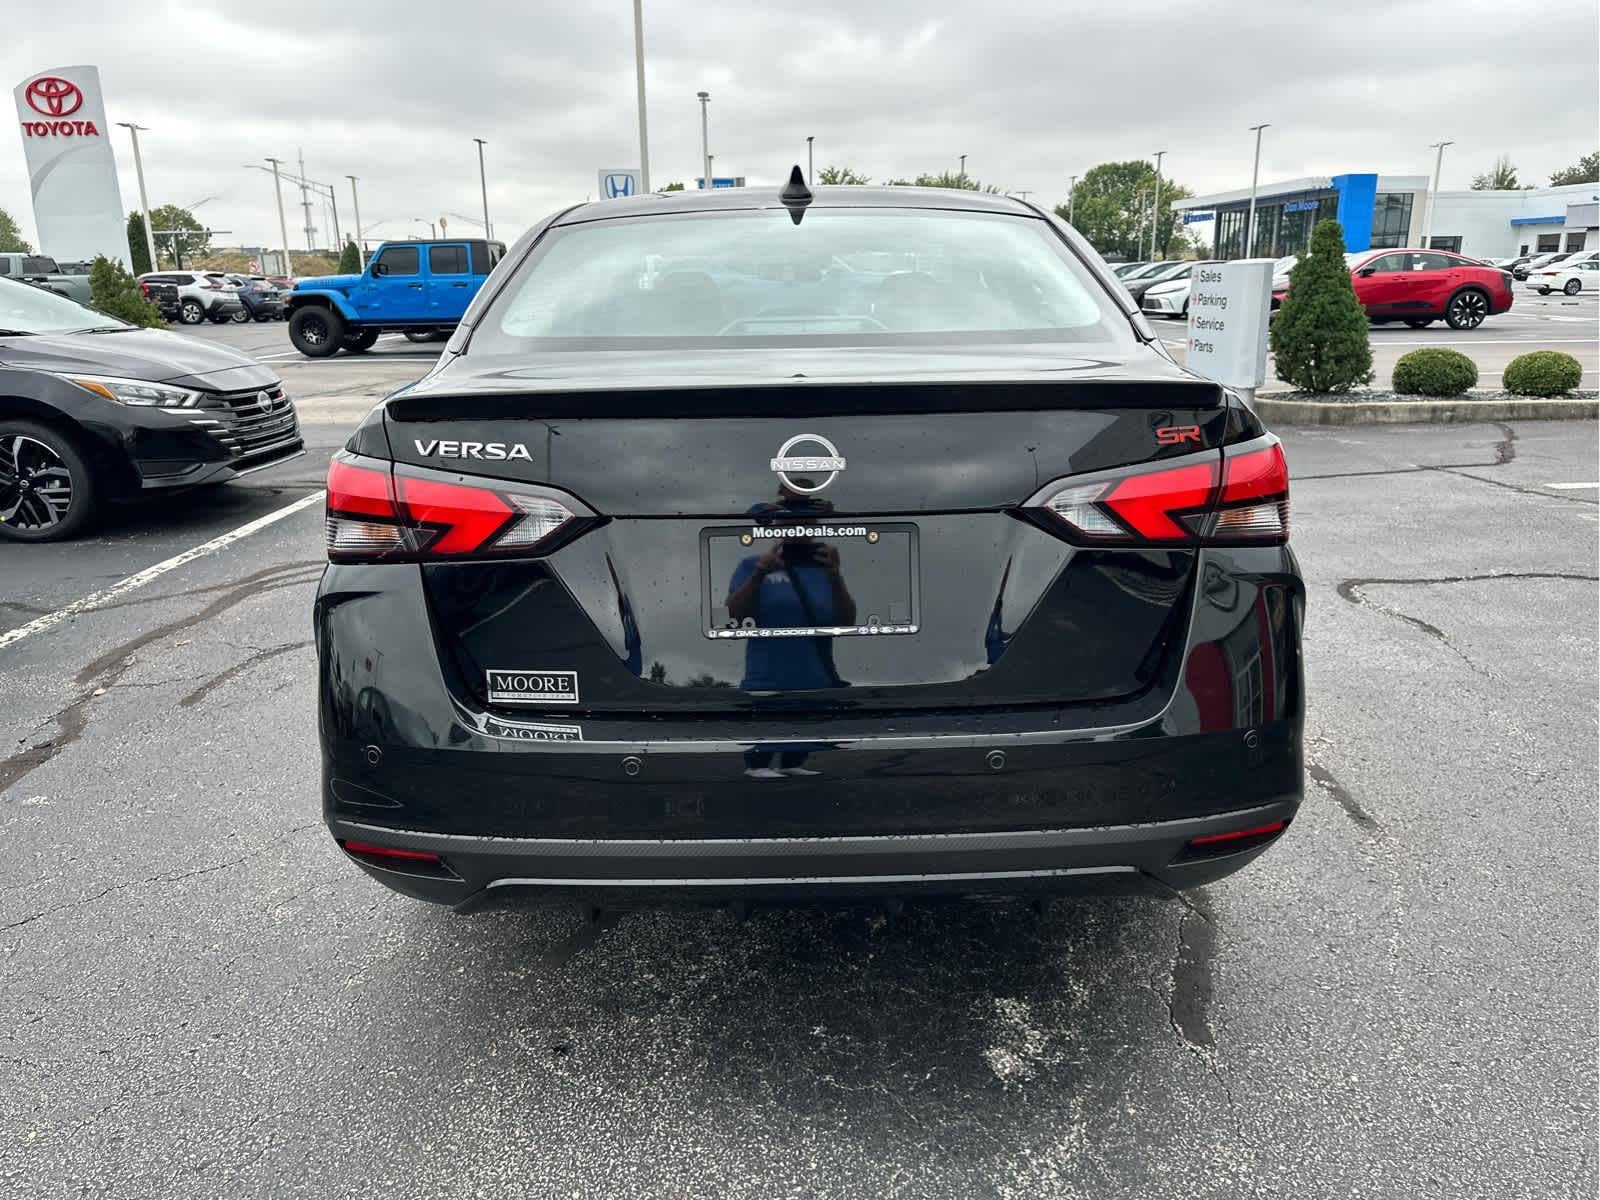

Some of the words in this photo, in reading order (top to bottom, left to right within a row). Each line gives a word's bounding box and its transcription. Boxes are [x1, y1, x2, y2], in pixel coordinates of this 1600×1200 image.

[22, 120, 99, 137] TOYOTA
[1200, 270, 1222, 283] Sales
[1198, 293, 1228, 310] Parking
[1196, 316, 1225, 331] Service
[1193, 339, 1214, 353] Parts
[1156, 425, 1201, 445] SR
[414, 439, 534, 462] VERSA
[772, 459, 845, 471] NISSAN
[752, 525, 867, 538] MooreDeals.com
[496, 675, 570, 692] MOORE
